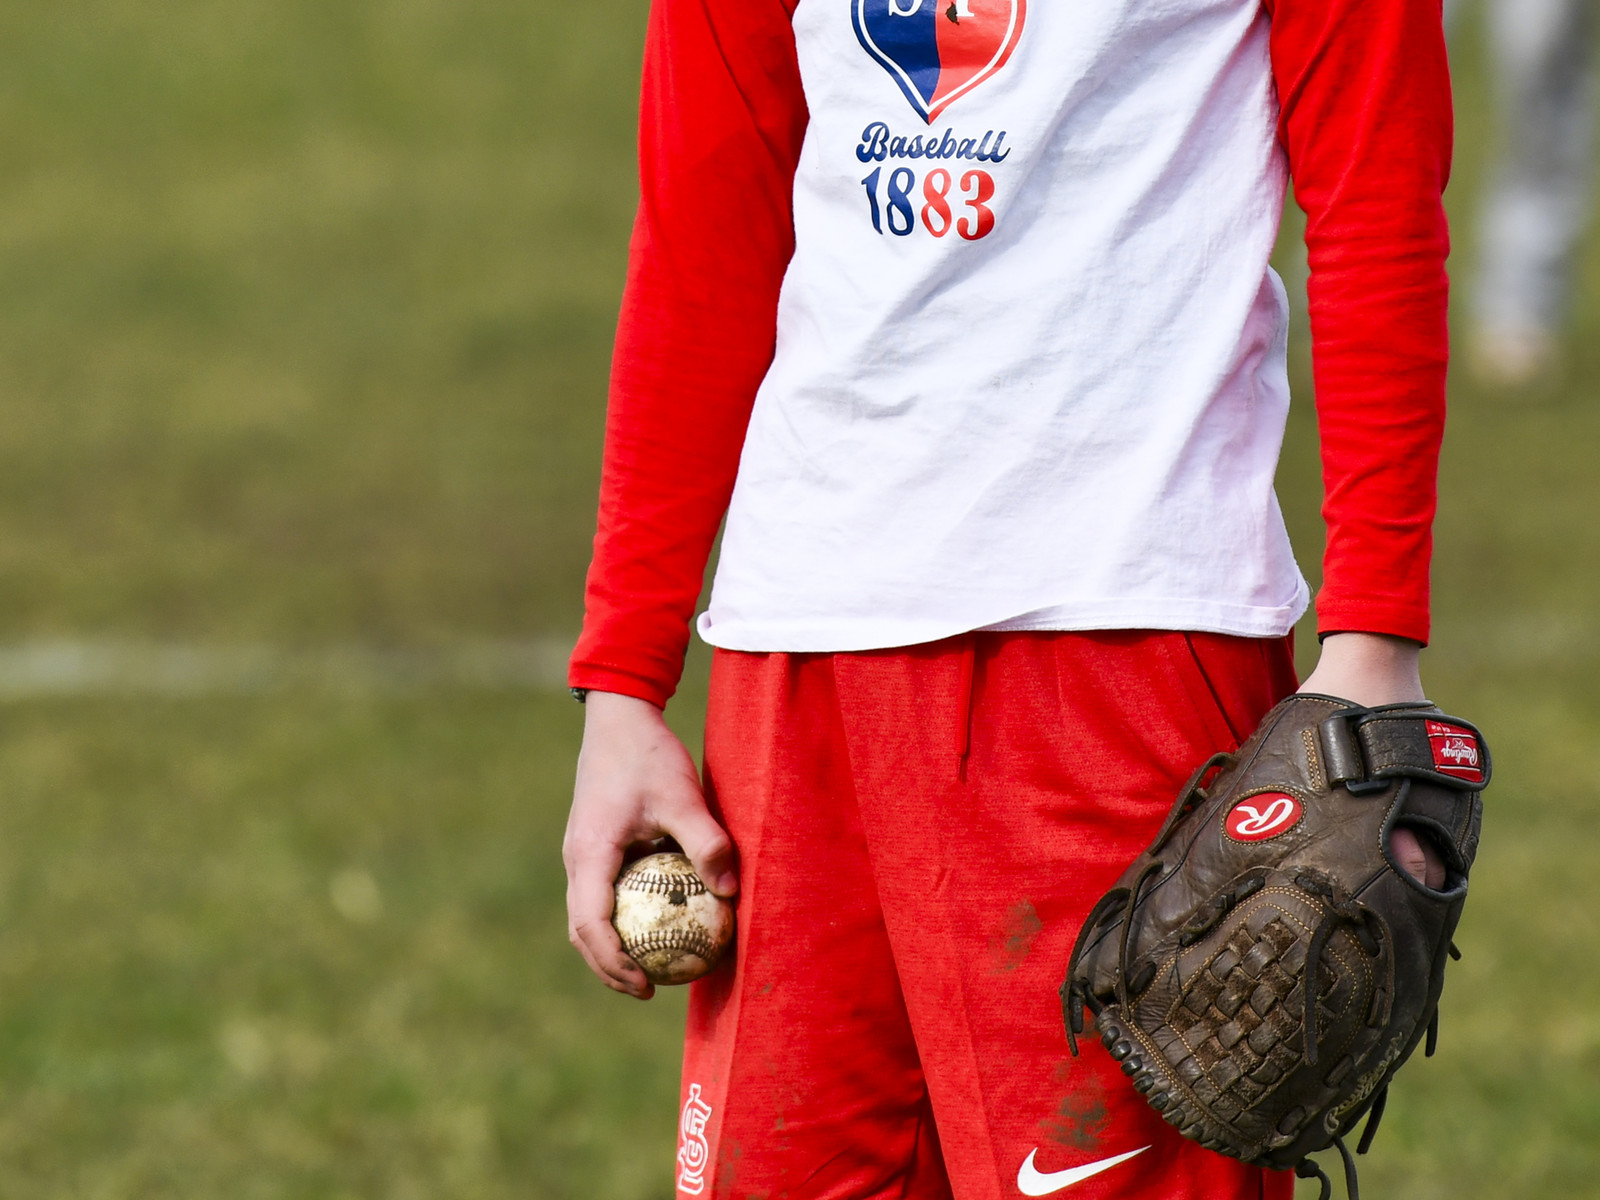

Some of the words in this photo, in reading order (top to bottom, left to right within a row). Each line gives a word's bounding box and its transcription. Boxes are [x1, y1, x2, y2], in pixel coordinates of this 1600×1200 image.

[855, 121, 1012, 163] Baseball
[861, 166, 995, 241] 1883
[1236, 798, 1294, 835] R
